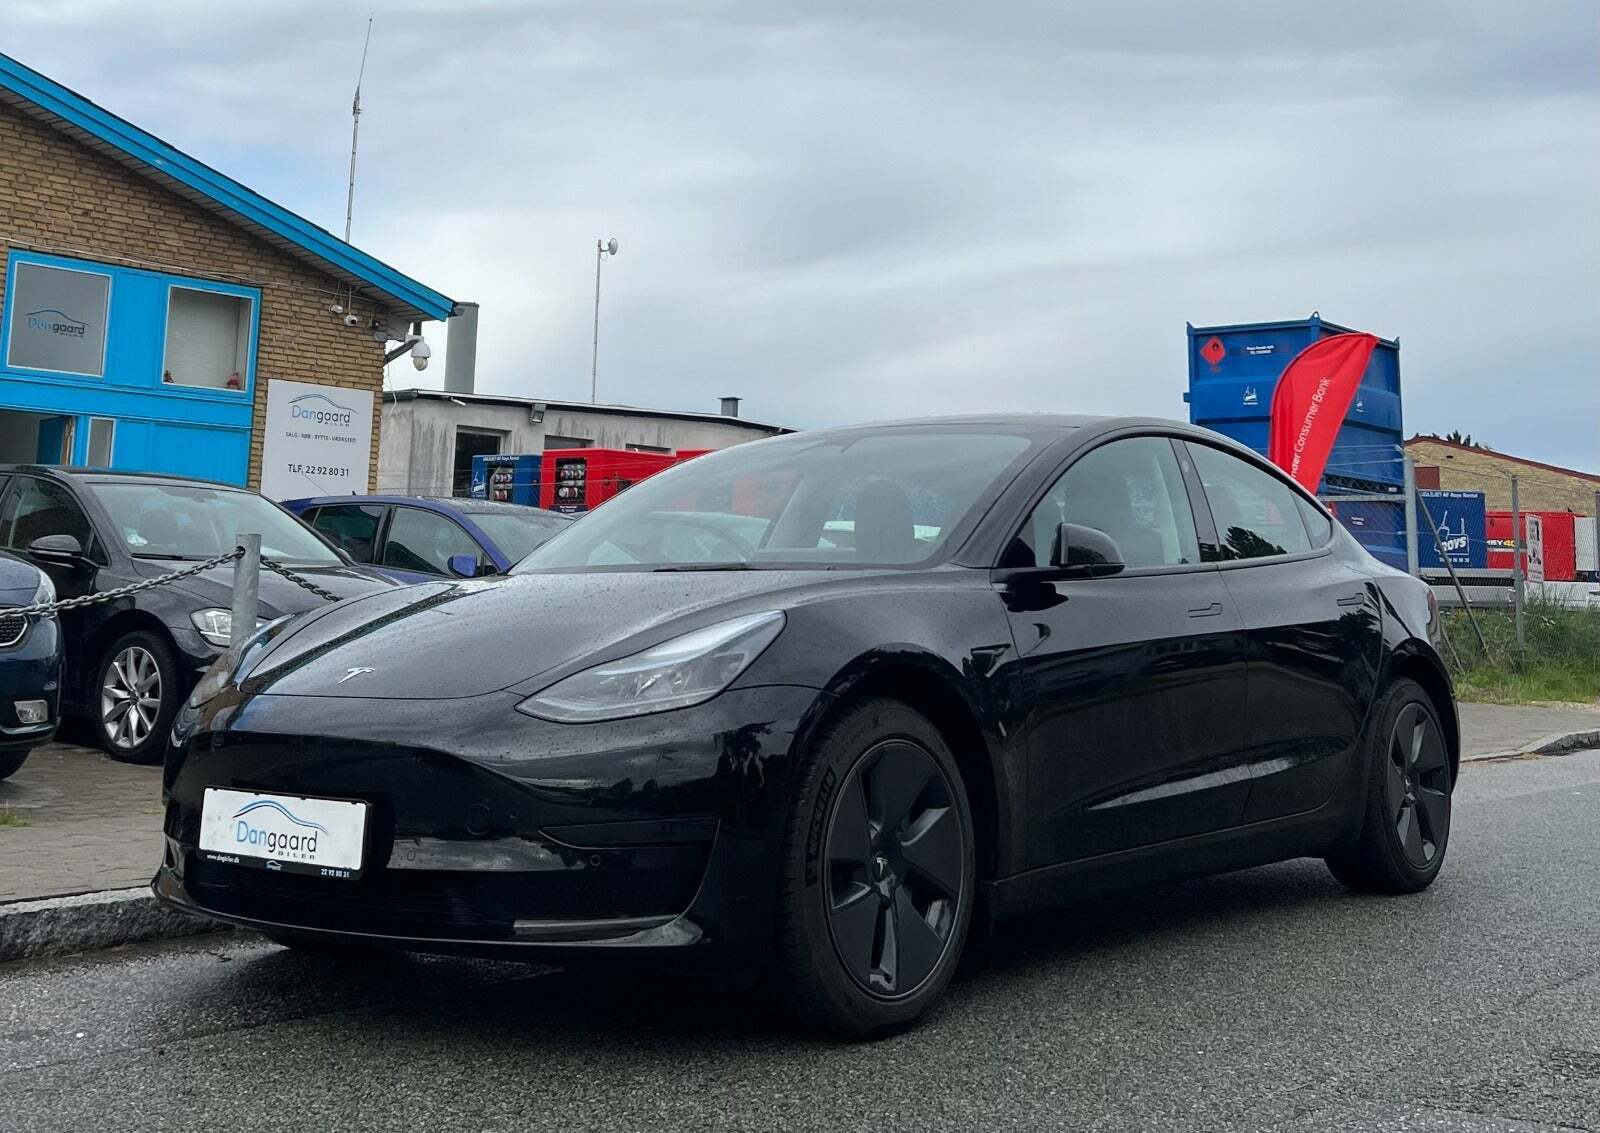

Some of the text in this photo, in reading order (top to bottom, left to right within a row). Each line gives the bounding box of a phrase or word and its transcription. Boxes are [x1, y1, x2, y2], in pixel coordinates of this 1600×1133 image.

[291, 404, 351, 424] Dangaard
[1294, 400, 1321, 453] Consumer
[1312, 376, 1331, 403] Bank
[305, 465, 316, 475] 22
[317, 466, 327, 475] 92
[328, 467, 339, 476] 80
[340, 468, 349, 477] 31
[236, 820, 318, 853] Dangaard
